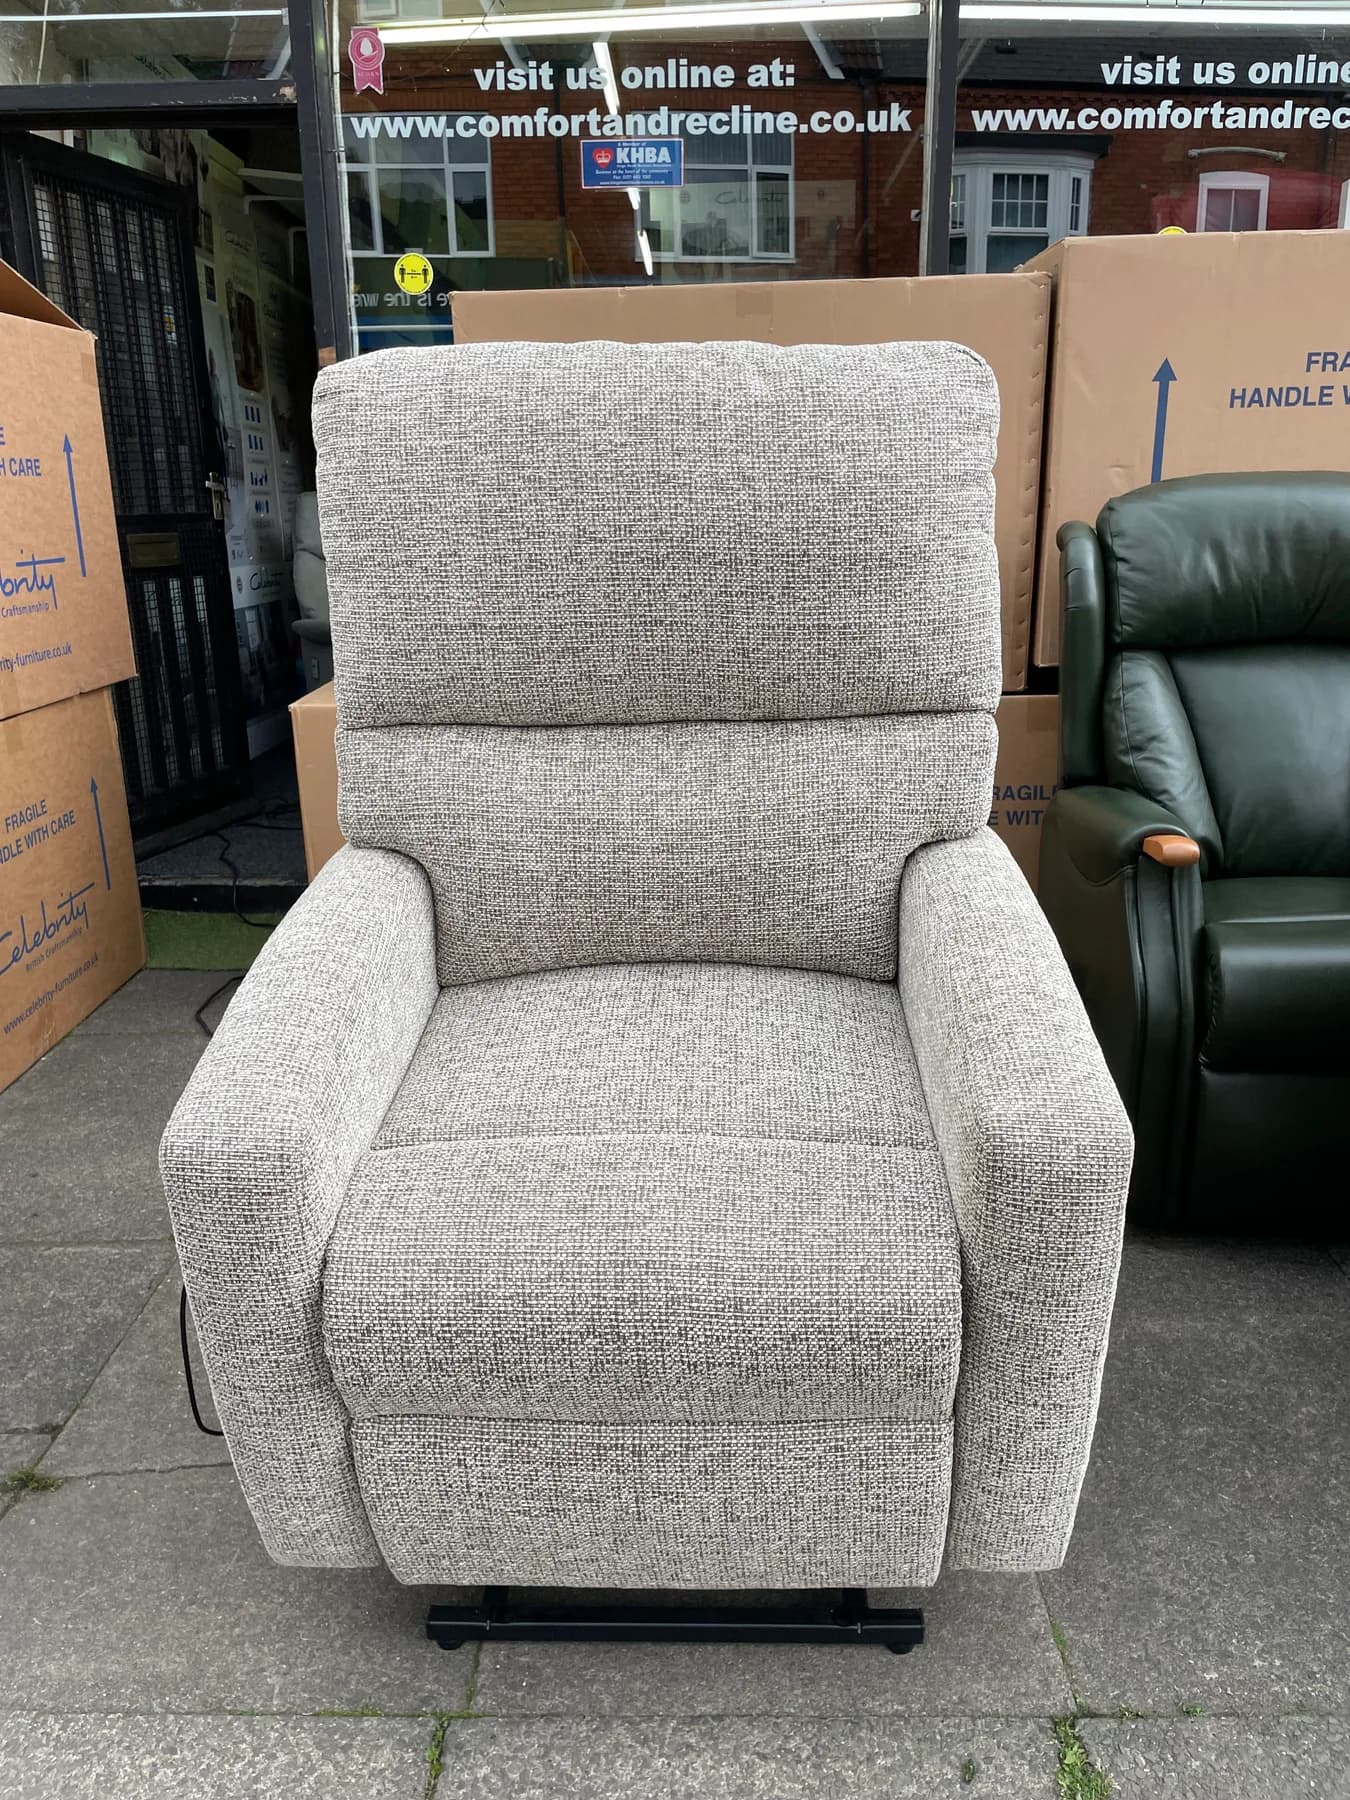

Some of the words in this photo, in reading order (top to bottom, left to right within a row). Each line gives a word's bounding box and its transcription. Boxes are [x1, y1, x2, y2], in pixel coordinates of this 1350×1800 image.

[474, 61, 554, 91] visit
[566, 68, 608, 90] us
[621, 58, 735, 88] online
[747, 57, 795, 87] at:
[1100, 55, 1181, 85] visit
[1193, 61, 1235, 84] us
[350, 103, 912, 138] www.comfortandrecline.co.uk
[971, 100, 1350, 132] www.comfortandrec
[616, 147, 672, 164] KHBA
[1229, 386, 1334, 408] HANDLE
[9, 458, 41, 476] CARE
[5, 799, 48, 832] FRAGILE
[24, 824, 50, 849] WITH
[50, 809, 76, 835] CARE
